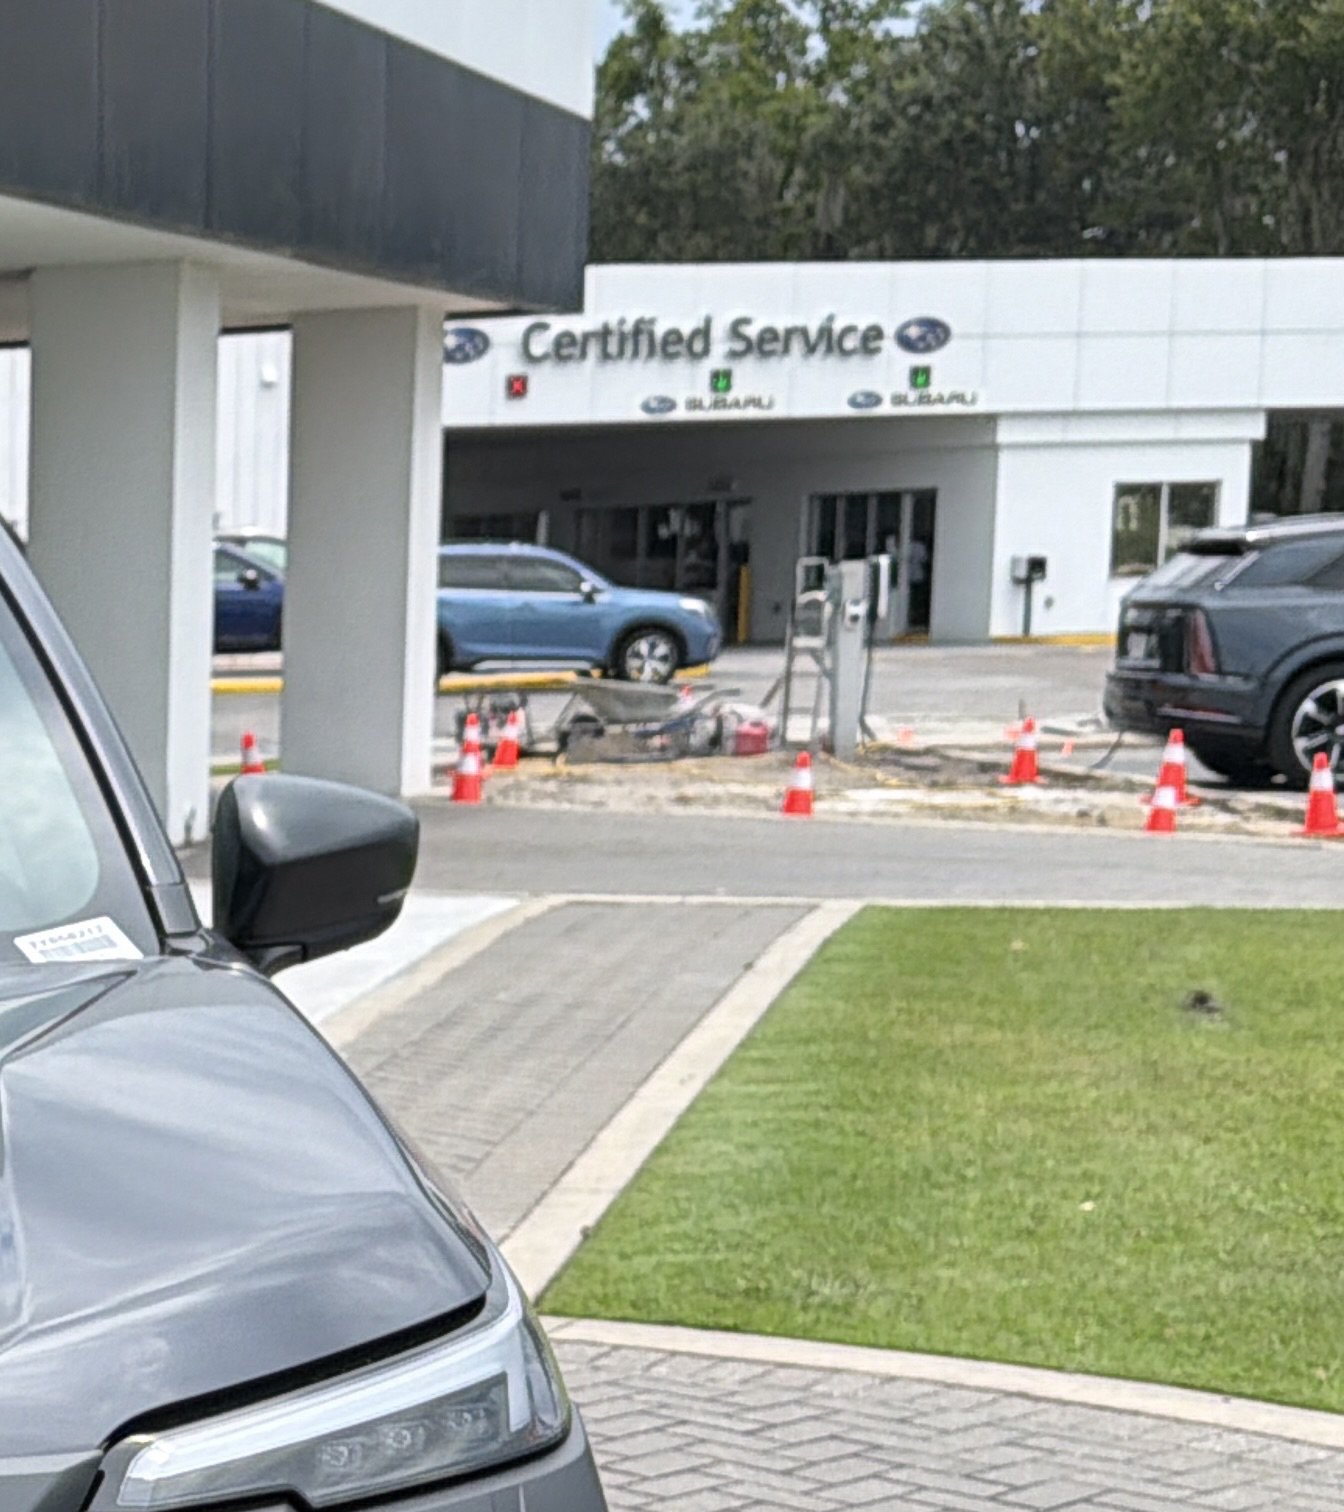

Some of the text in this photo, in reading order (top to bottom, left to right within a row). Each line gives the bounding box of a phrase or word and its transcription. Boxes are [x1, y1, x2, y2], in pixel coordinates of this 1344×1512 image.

[521, 313, 885, 364] Certified Service
[684, 394, 775, 412] SUBARU
[890, 390, 978, 408] SUBARU
